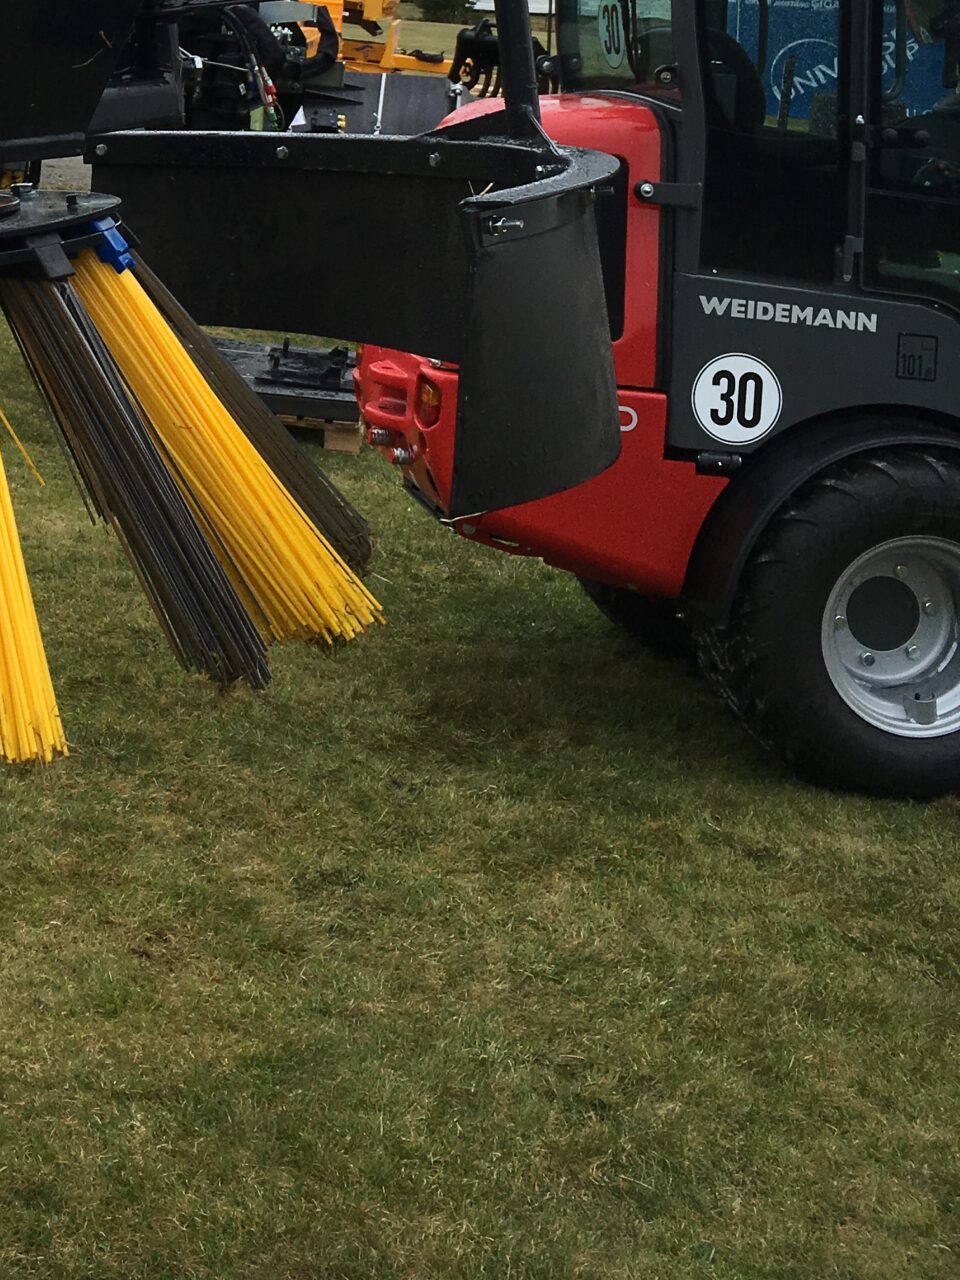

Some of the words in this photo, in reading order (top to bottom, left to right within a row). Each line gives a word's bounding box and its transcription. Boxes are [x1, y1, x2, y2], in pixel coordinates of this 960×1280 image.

[602, 4, 621, 55] 30
[699, 295, 878, 333] WEIDEMANN
[901, 354, 922, 377] 101
[709, 369, 764, 429] 30
